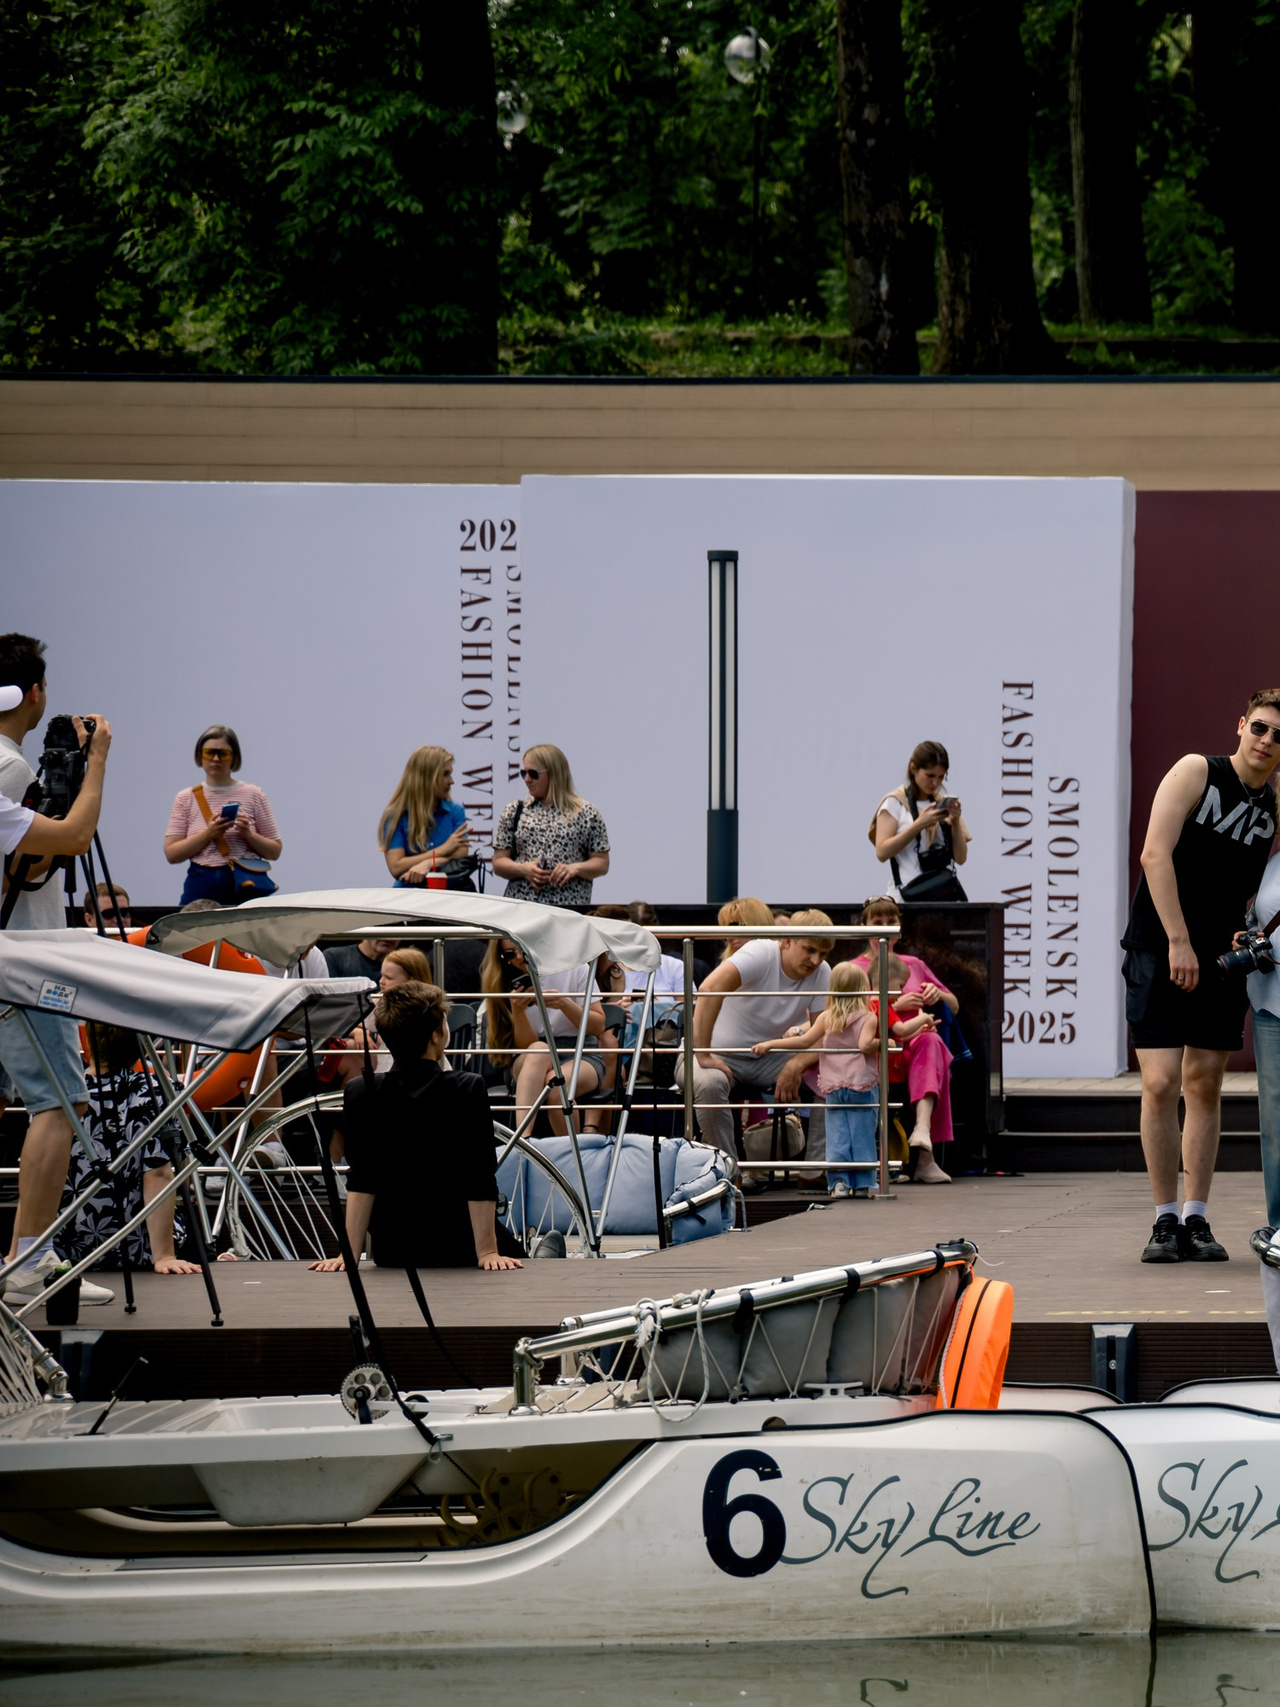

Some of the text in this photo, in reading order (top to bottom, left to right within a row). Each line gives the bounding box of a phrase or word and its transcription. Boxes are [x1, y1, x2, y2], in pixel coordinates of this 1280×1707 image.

[460, 566, 493, 740] FASHION
[1001, 680, 1034, 998] FASHION WEEK
[1046, 776, 1080, 999] SMOLENSK
[1001, 1010, 1077, 1045] 2025
[702, 1449, 786, 1578] 6
